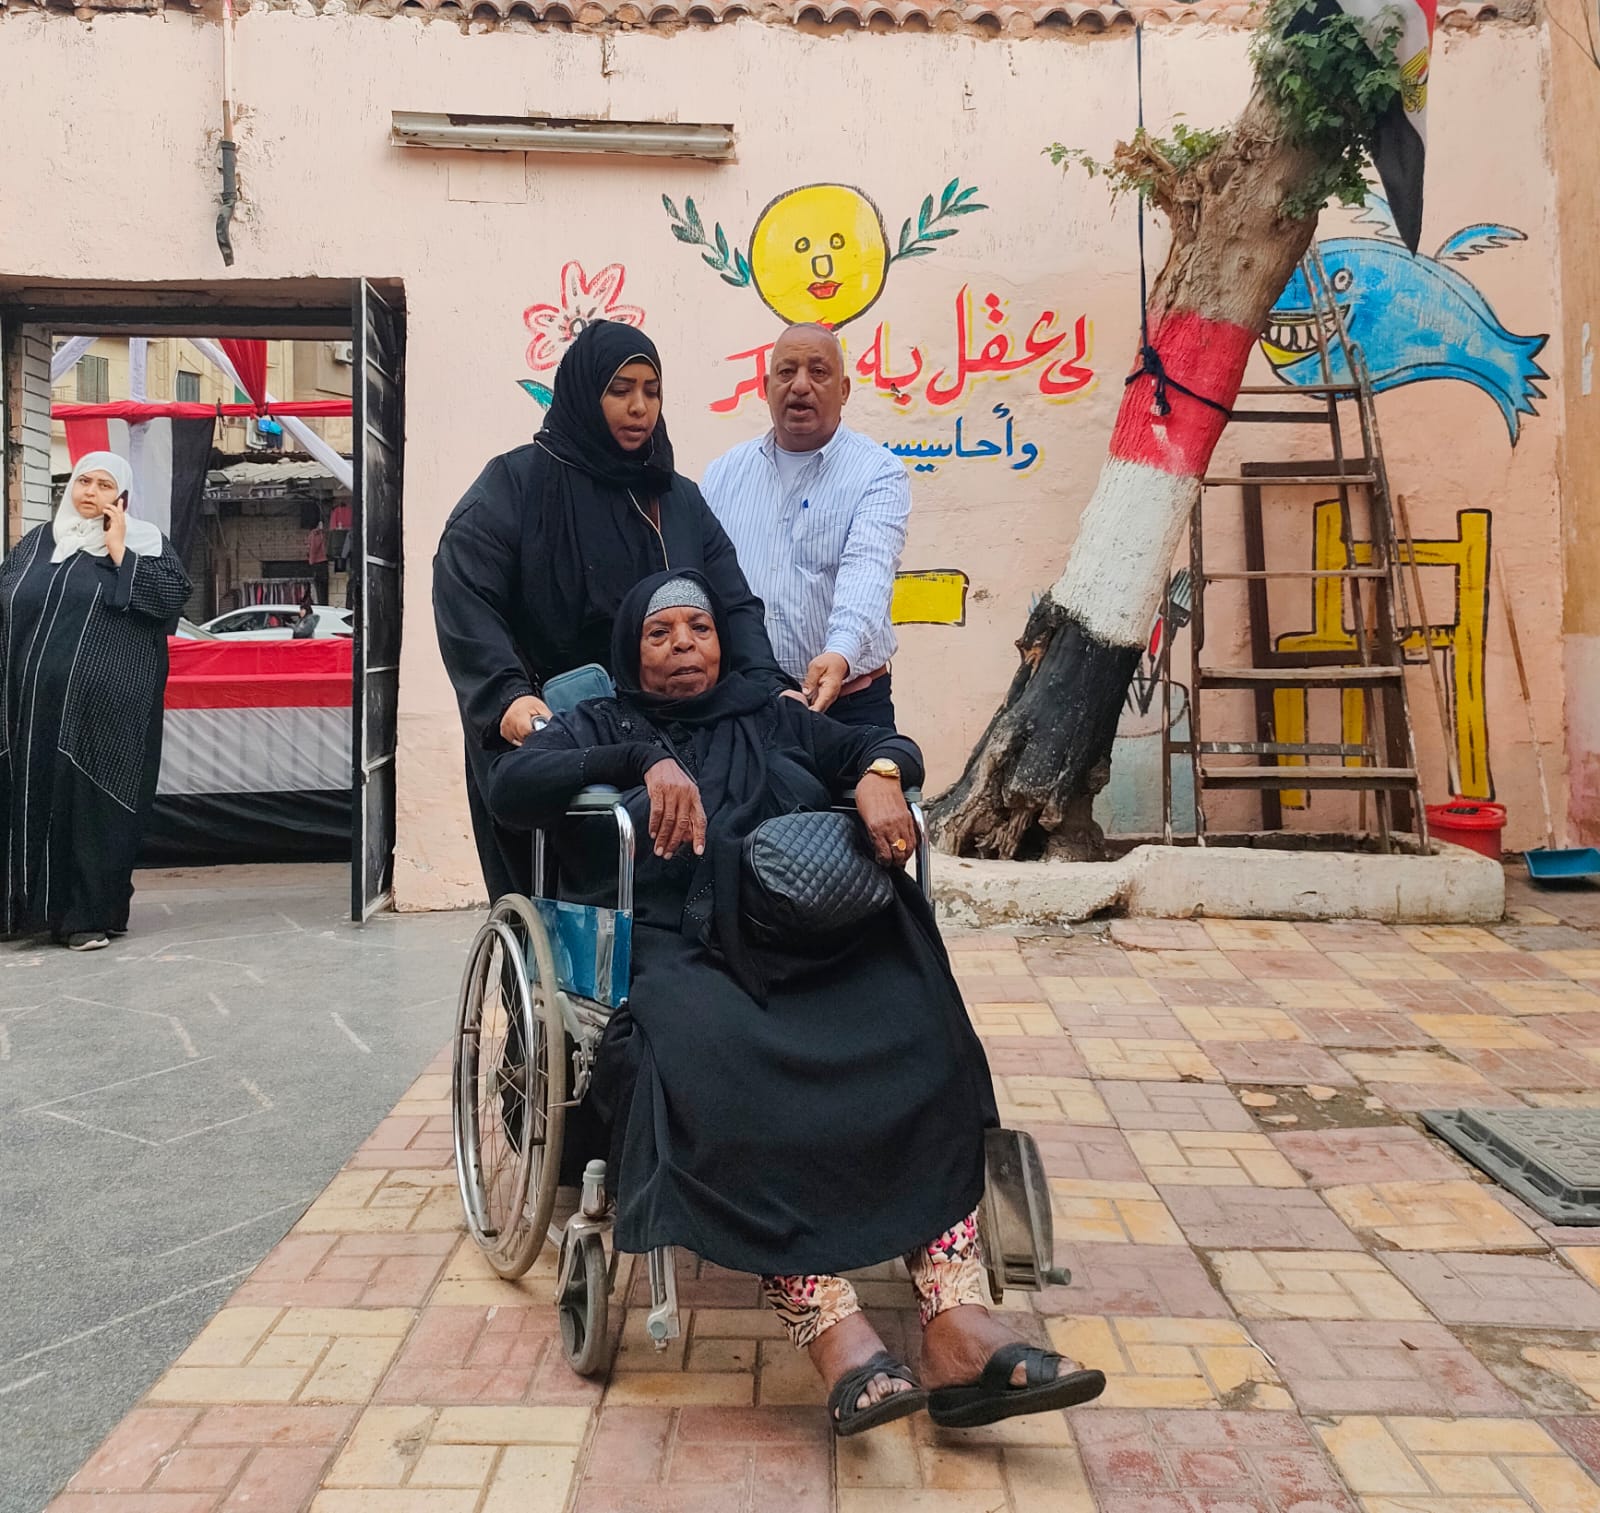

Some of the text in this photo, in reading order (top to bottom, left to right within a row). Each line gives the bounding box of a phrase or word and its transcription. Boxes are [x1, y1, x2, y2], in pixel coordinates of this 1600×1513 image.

[857, 322, 922, 405] به
[926, 283, 1066, 405] عقل
[1040, 314, 1093, 394] لى
